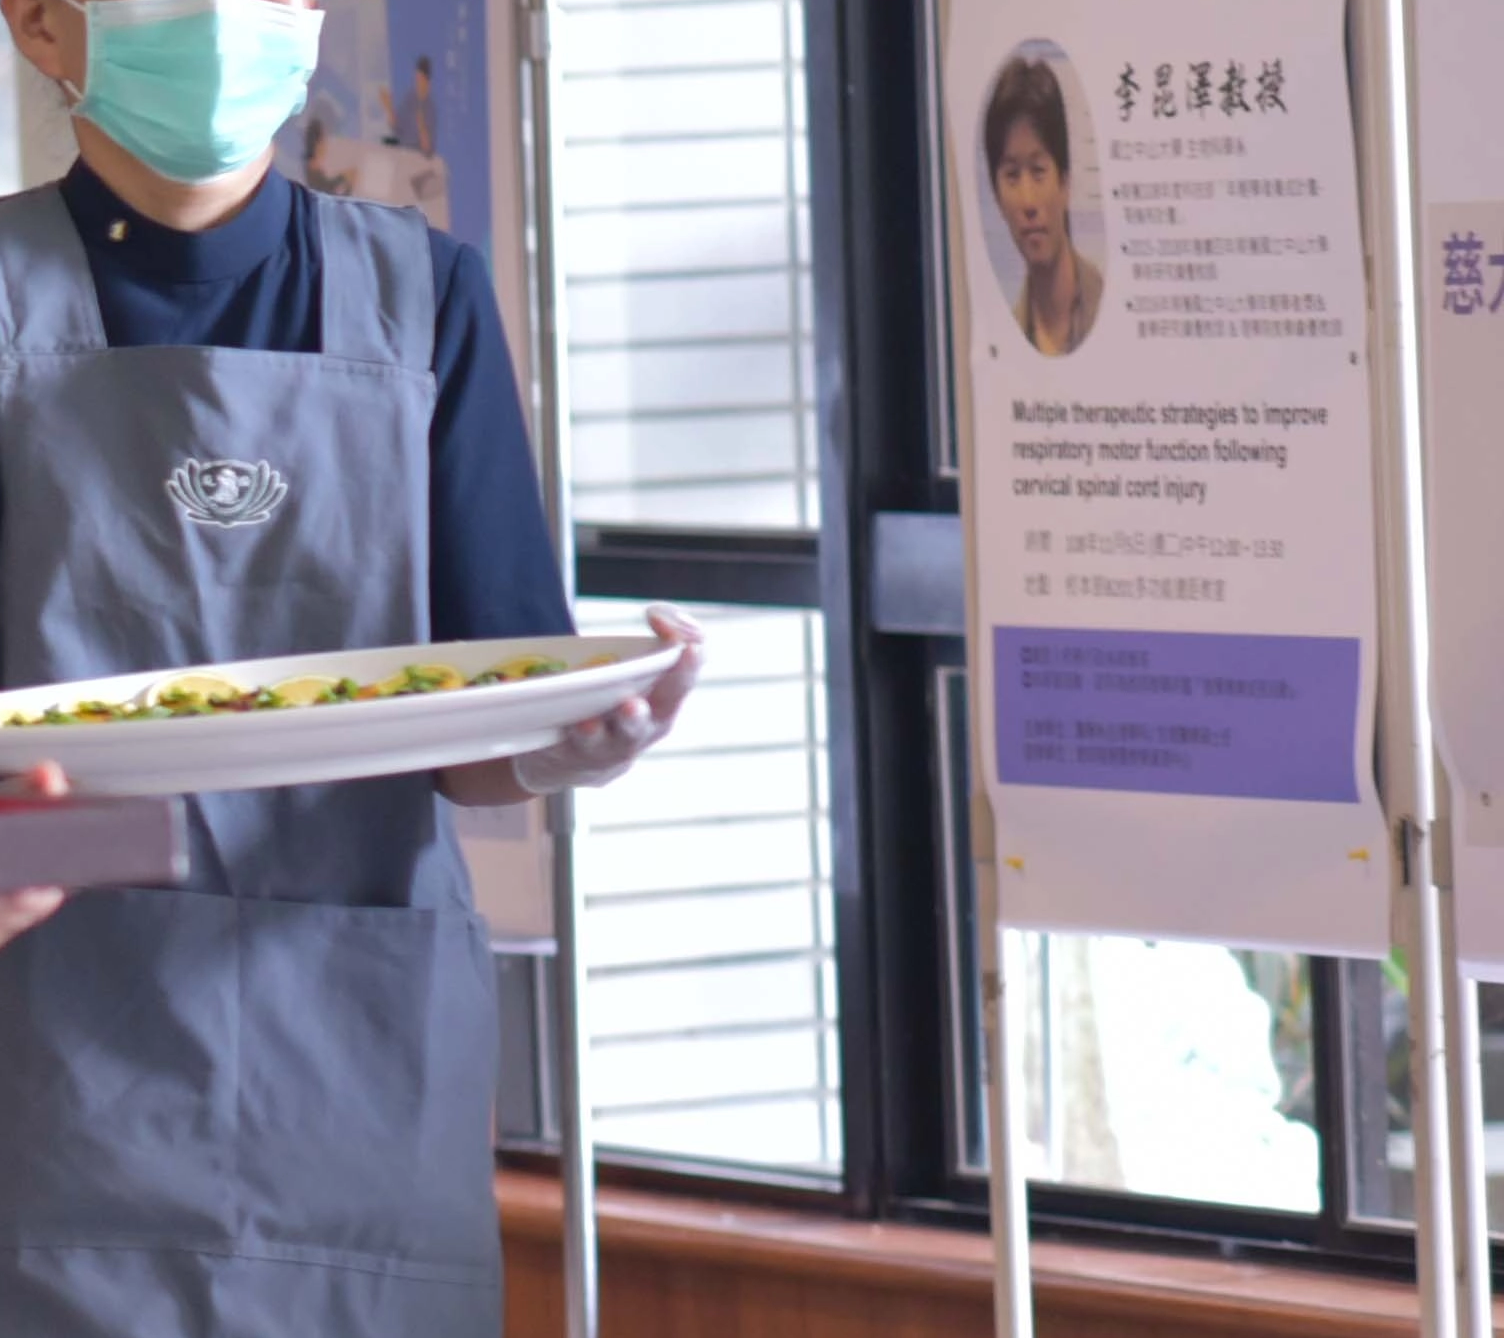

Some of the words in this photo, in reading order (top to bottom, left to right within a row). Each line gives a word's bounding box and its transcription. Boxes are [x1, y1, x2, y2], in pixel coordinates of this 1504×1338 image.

[1013, 400, 1067, 428] Multiple
[1071, 400, 1156, 428] therapeutic
[1161, 401, 1238, 431] strategies
[1241, 402, 1259, 424] to
[1263, 401, 1328, 430] improve
[1013, 438, 1093, 466] respiratory
[1098, 439, 1142, 461] motor
[1146, 437, 1210, 462] function
[1213, 438, 1287, 469] following
[1013, 473, 1072, 496] cervical
[1076, 473, 1121, 502] spinal
[1125, 474, 1160, 498] cord
[1164, 475, 1207, 505] injury
